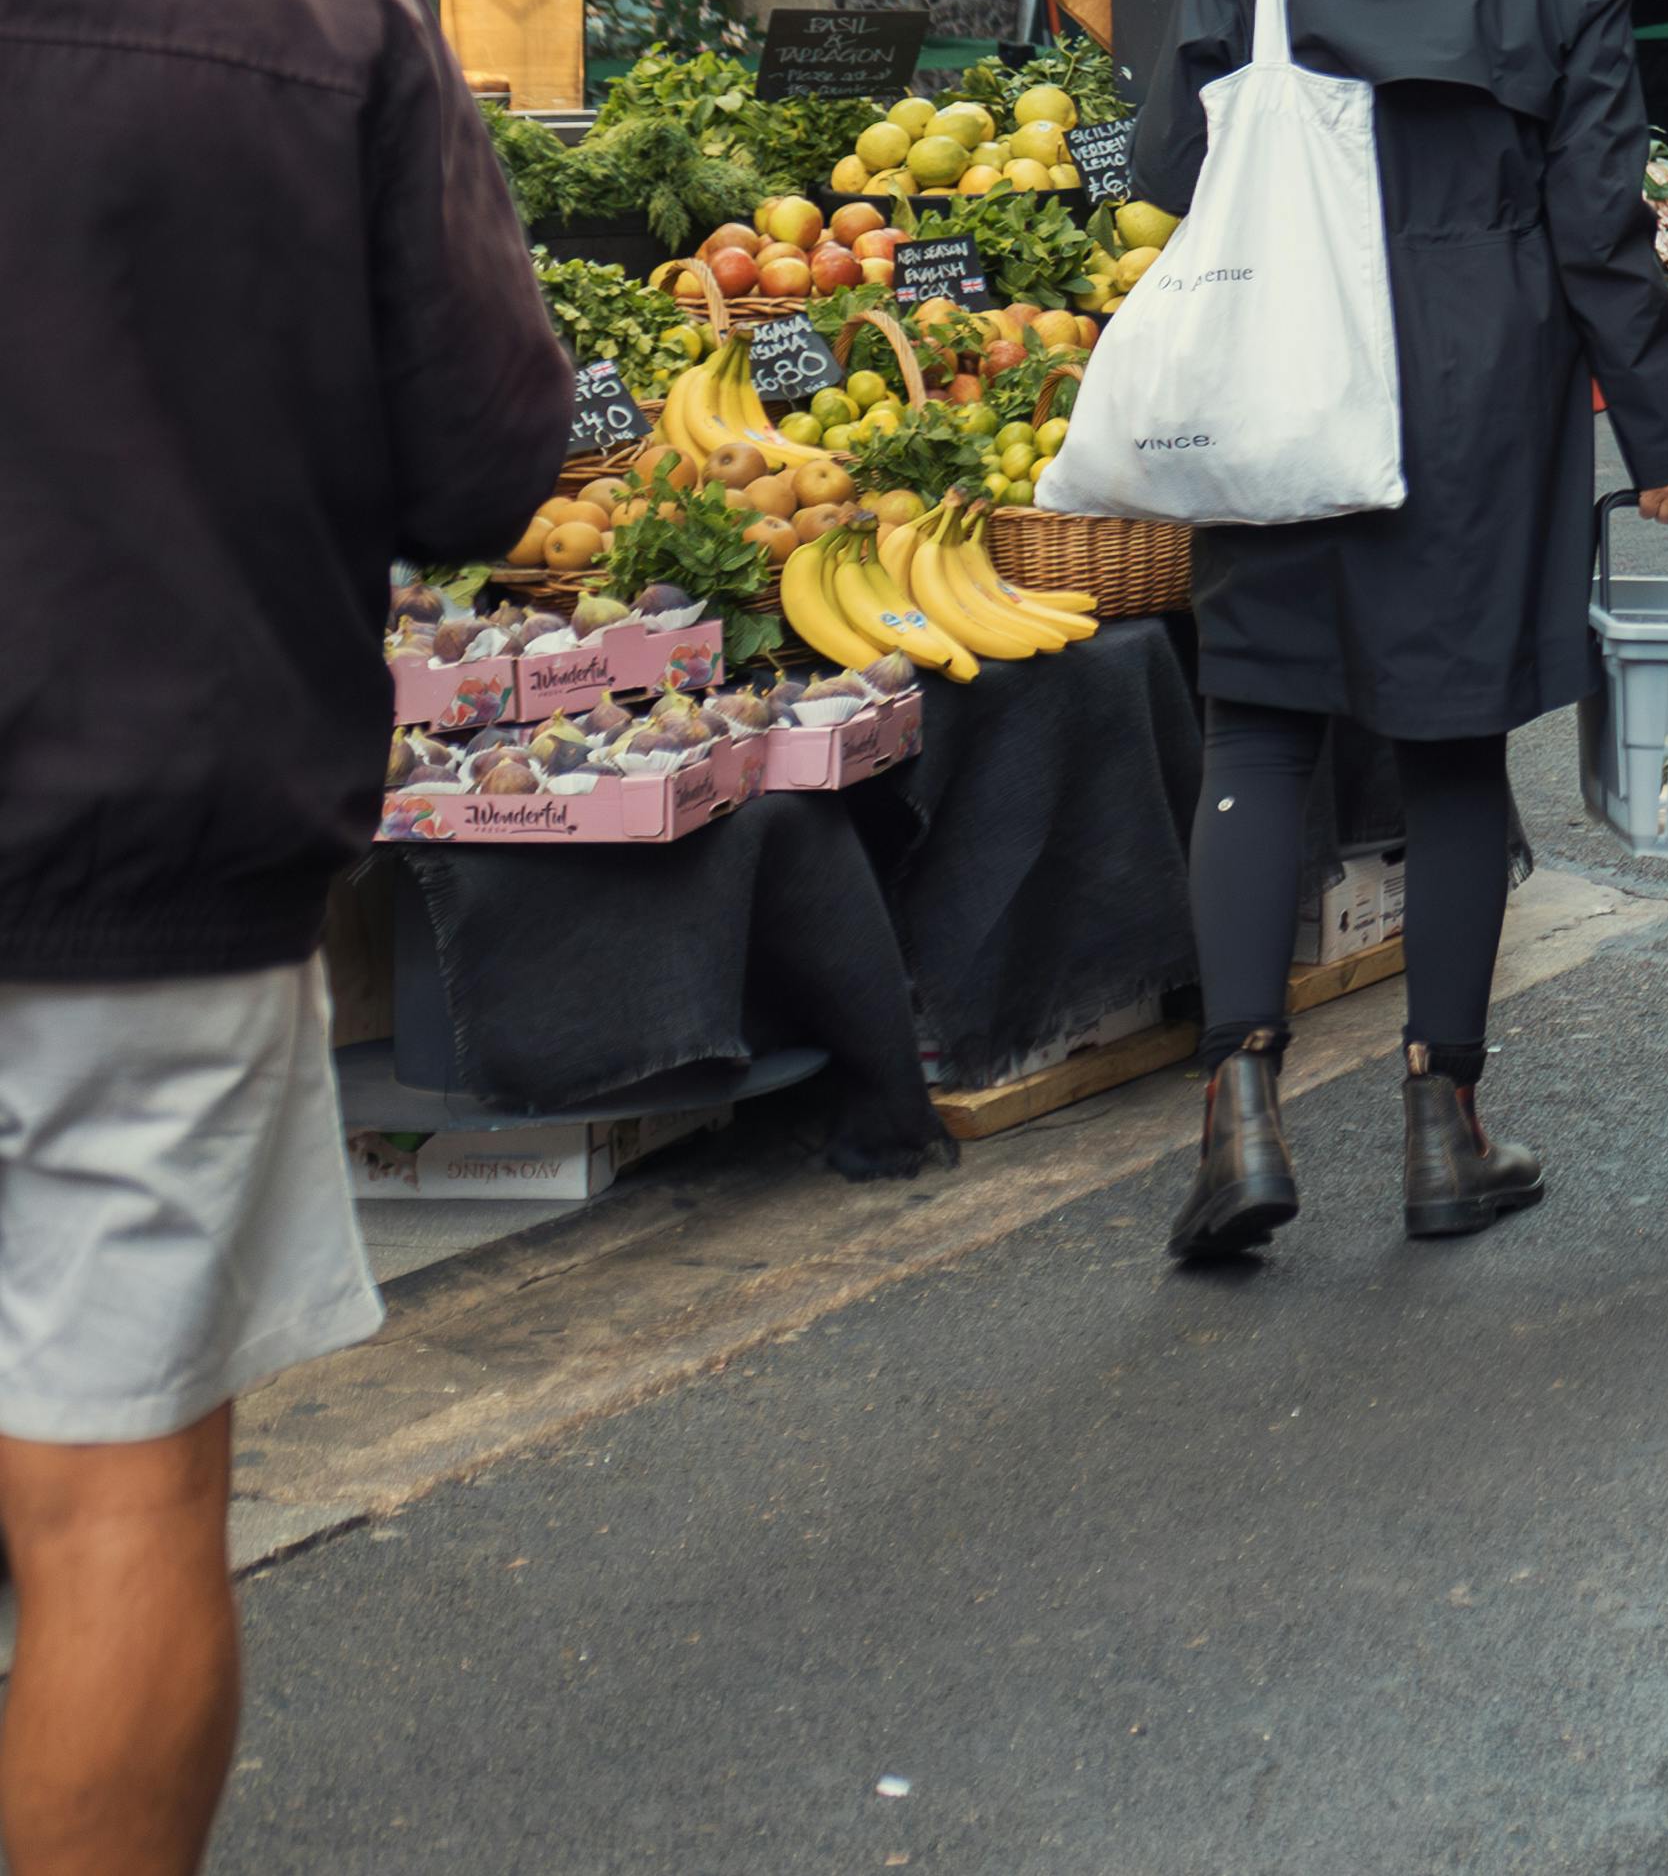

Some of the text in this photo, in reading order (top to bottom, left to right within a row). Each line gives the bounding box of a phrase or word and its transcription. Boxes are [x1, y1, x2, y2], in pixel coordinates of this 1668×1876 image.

[803, 16, 881, 34] BASIL
[775, 45, 897, 64] TARRAGON
[1081, 152, 1127, 172] LEMO
[923, 241, 969, 261] SEASON
[918, 280, 955, 302] COX
[529, 656, 609, 691] Wonderful
[464, 800, 568, 829] Wonderful
